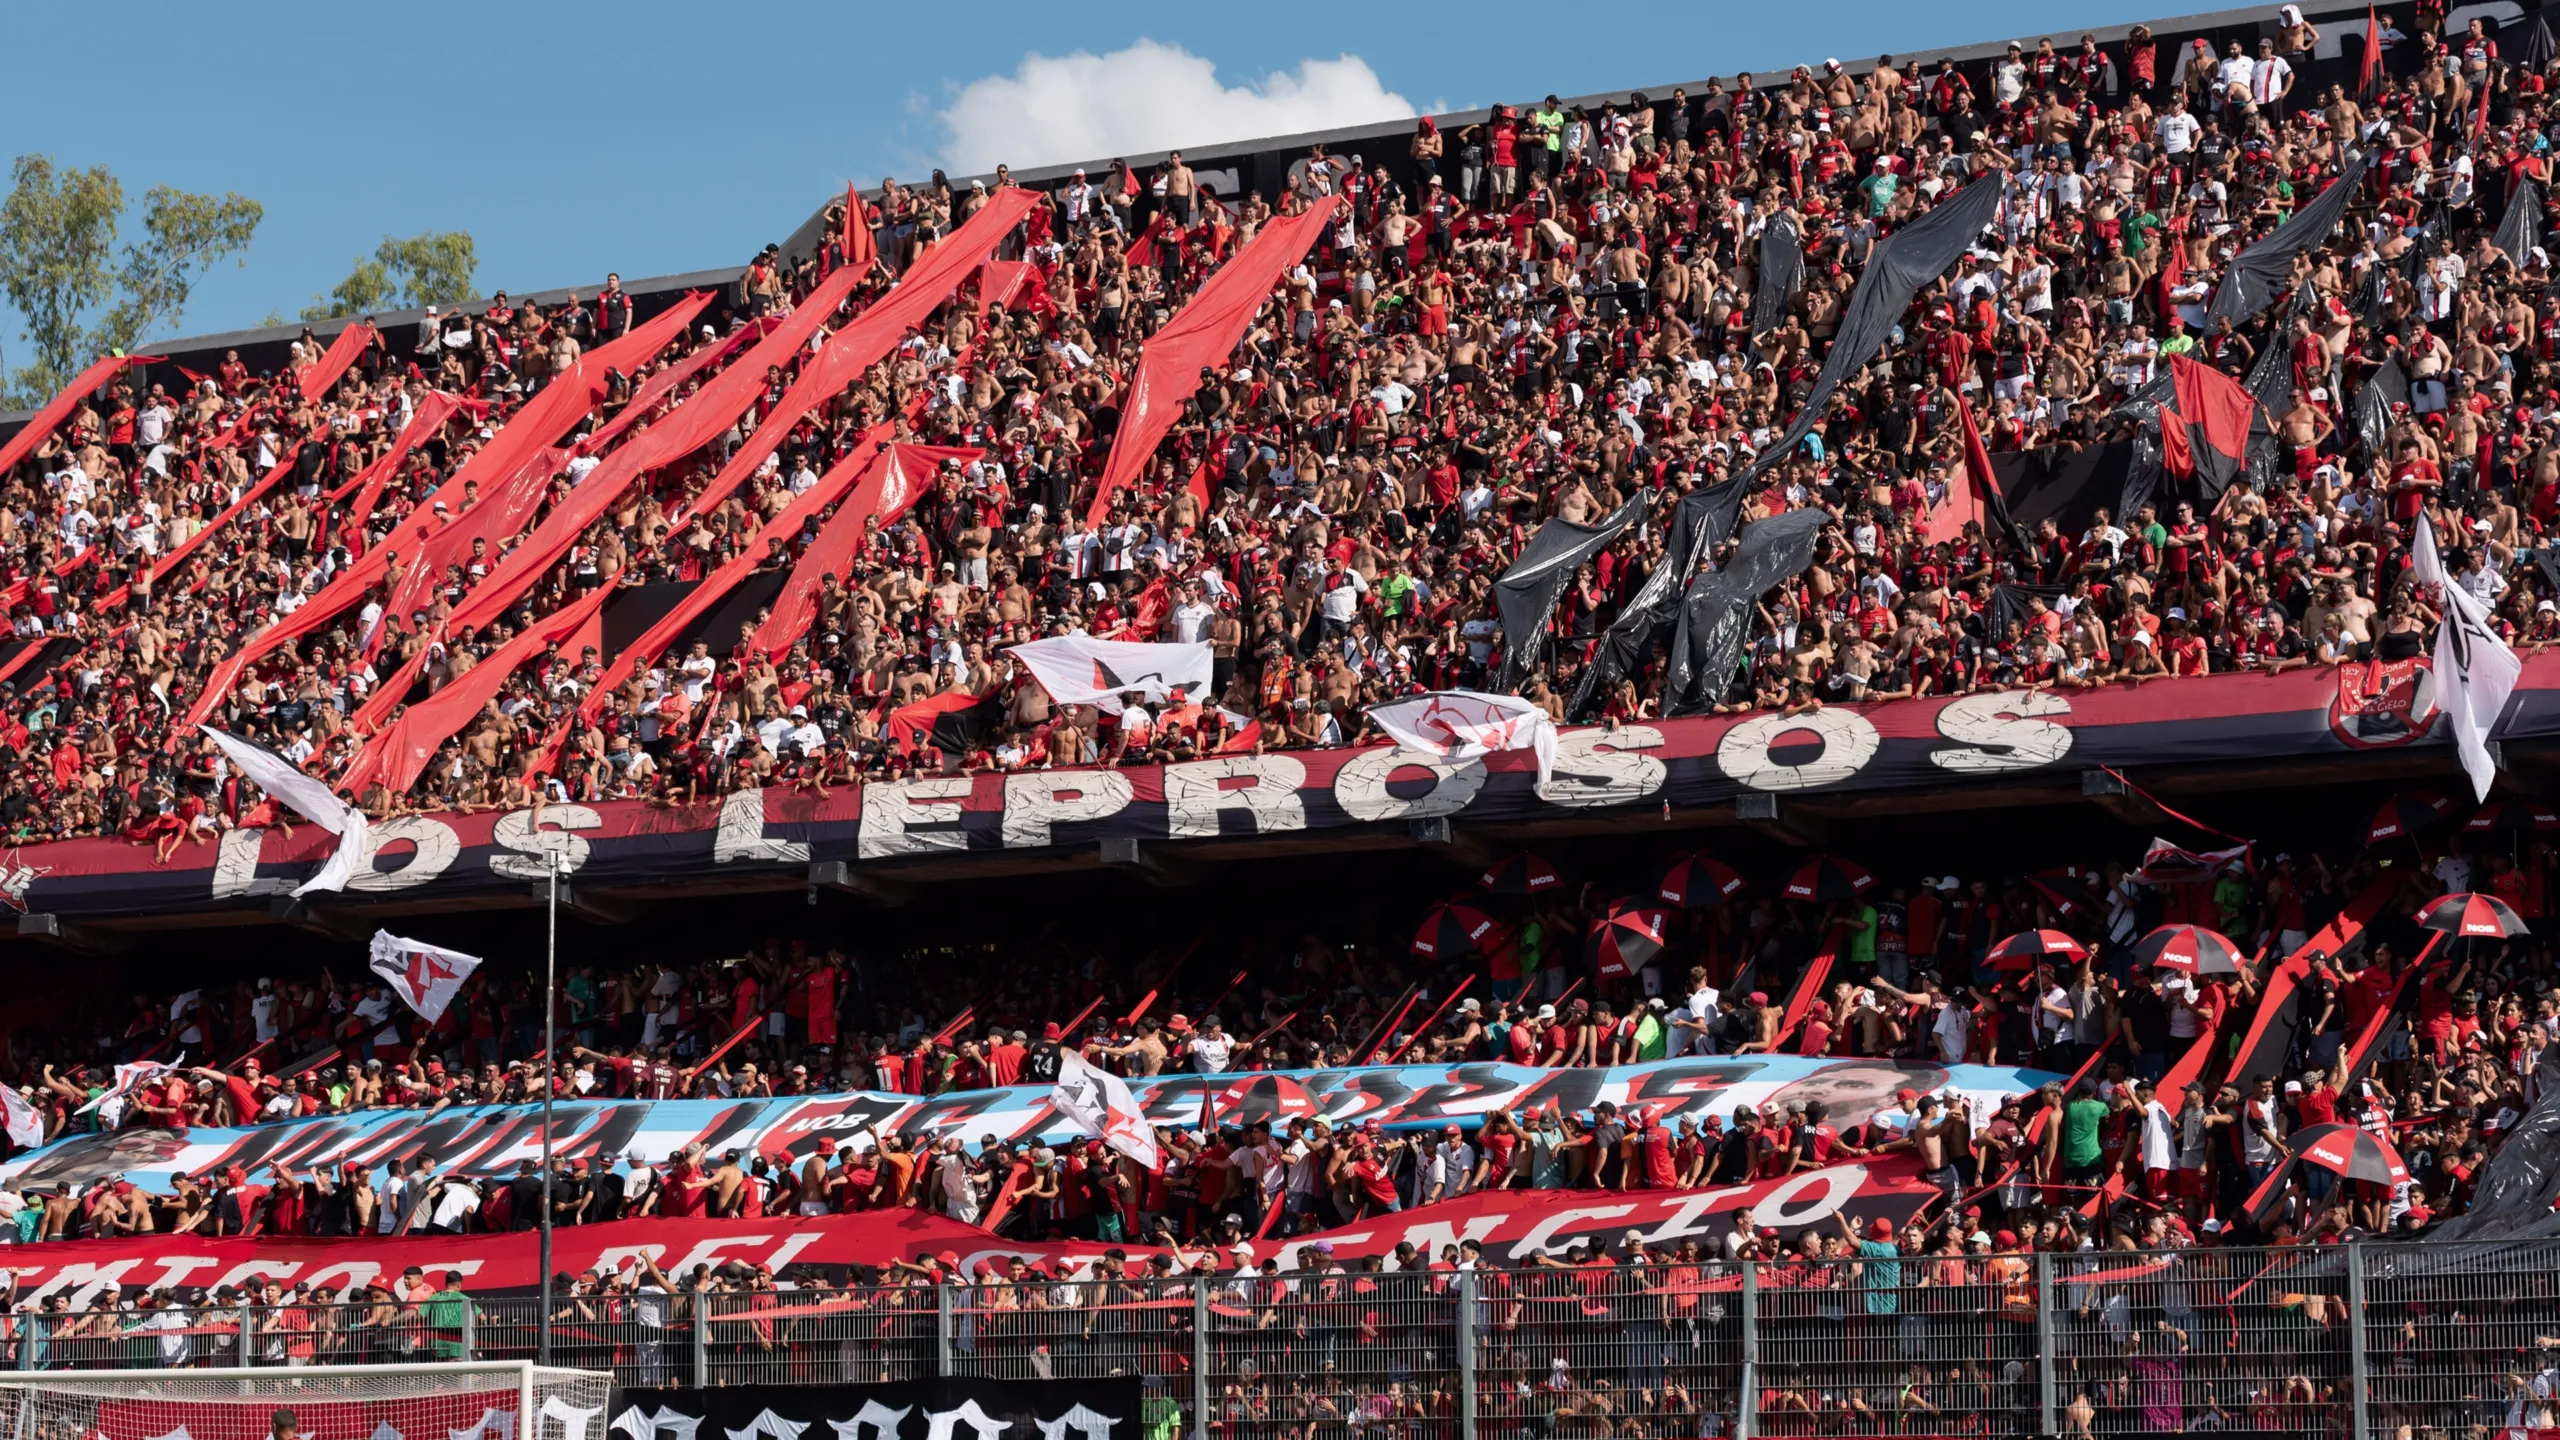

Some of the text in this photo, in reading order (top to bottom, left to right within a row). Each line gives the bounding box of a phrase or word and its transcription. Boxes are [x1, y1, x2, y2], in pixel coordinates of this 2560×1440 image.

[212, 689, 2074, 900] LOS LEPROSOS
[2470, 819, 2491, 827] NOB
[2534, 814, 2556, 822] NOB
[2373, 825, 2397, 838] NOB
[1530, 875, 1556, 887] NOB
[1722, 878, 1741, 894] NOB
[1853, 875, 1872, 889] NOB
[1662, 889, 1681, 902] NOB
[1789, 884, 1812, 896] NOB
[1470, 921, 1491, 941] NOB
[1651, 914, 1662, 938] NOB
[2467, 924, 2496, 934] NOB
[1416, 940, 1434, 952] NOB
[2046, 941, 2073, 950] NOB
[2163, 952, 2193, 965] NOB
[1601, 963, 1624, 974] NOB
[1033, 1053, 1054, 1076] 74
[877, 1067, 893, 1091] 11
[1225, 1089, 1242, 1100] NOB
[1281, 1098, 1307, 1108] NOB
[788, 1113, 871, 1132] NOB
[2313, 1147, 2344, 1166] NOB
